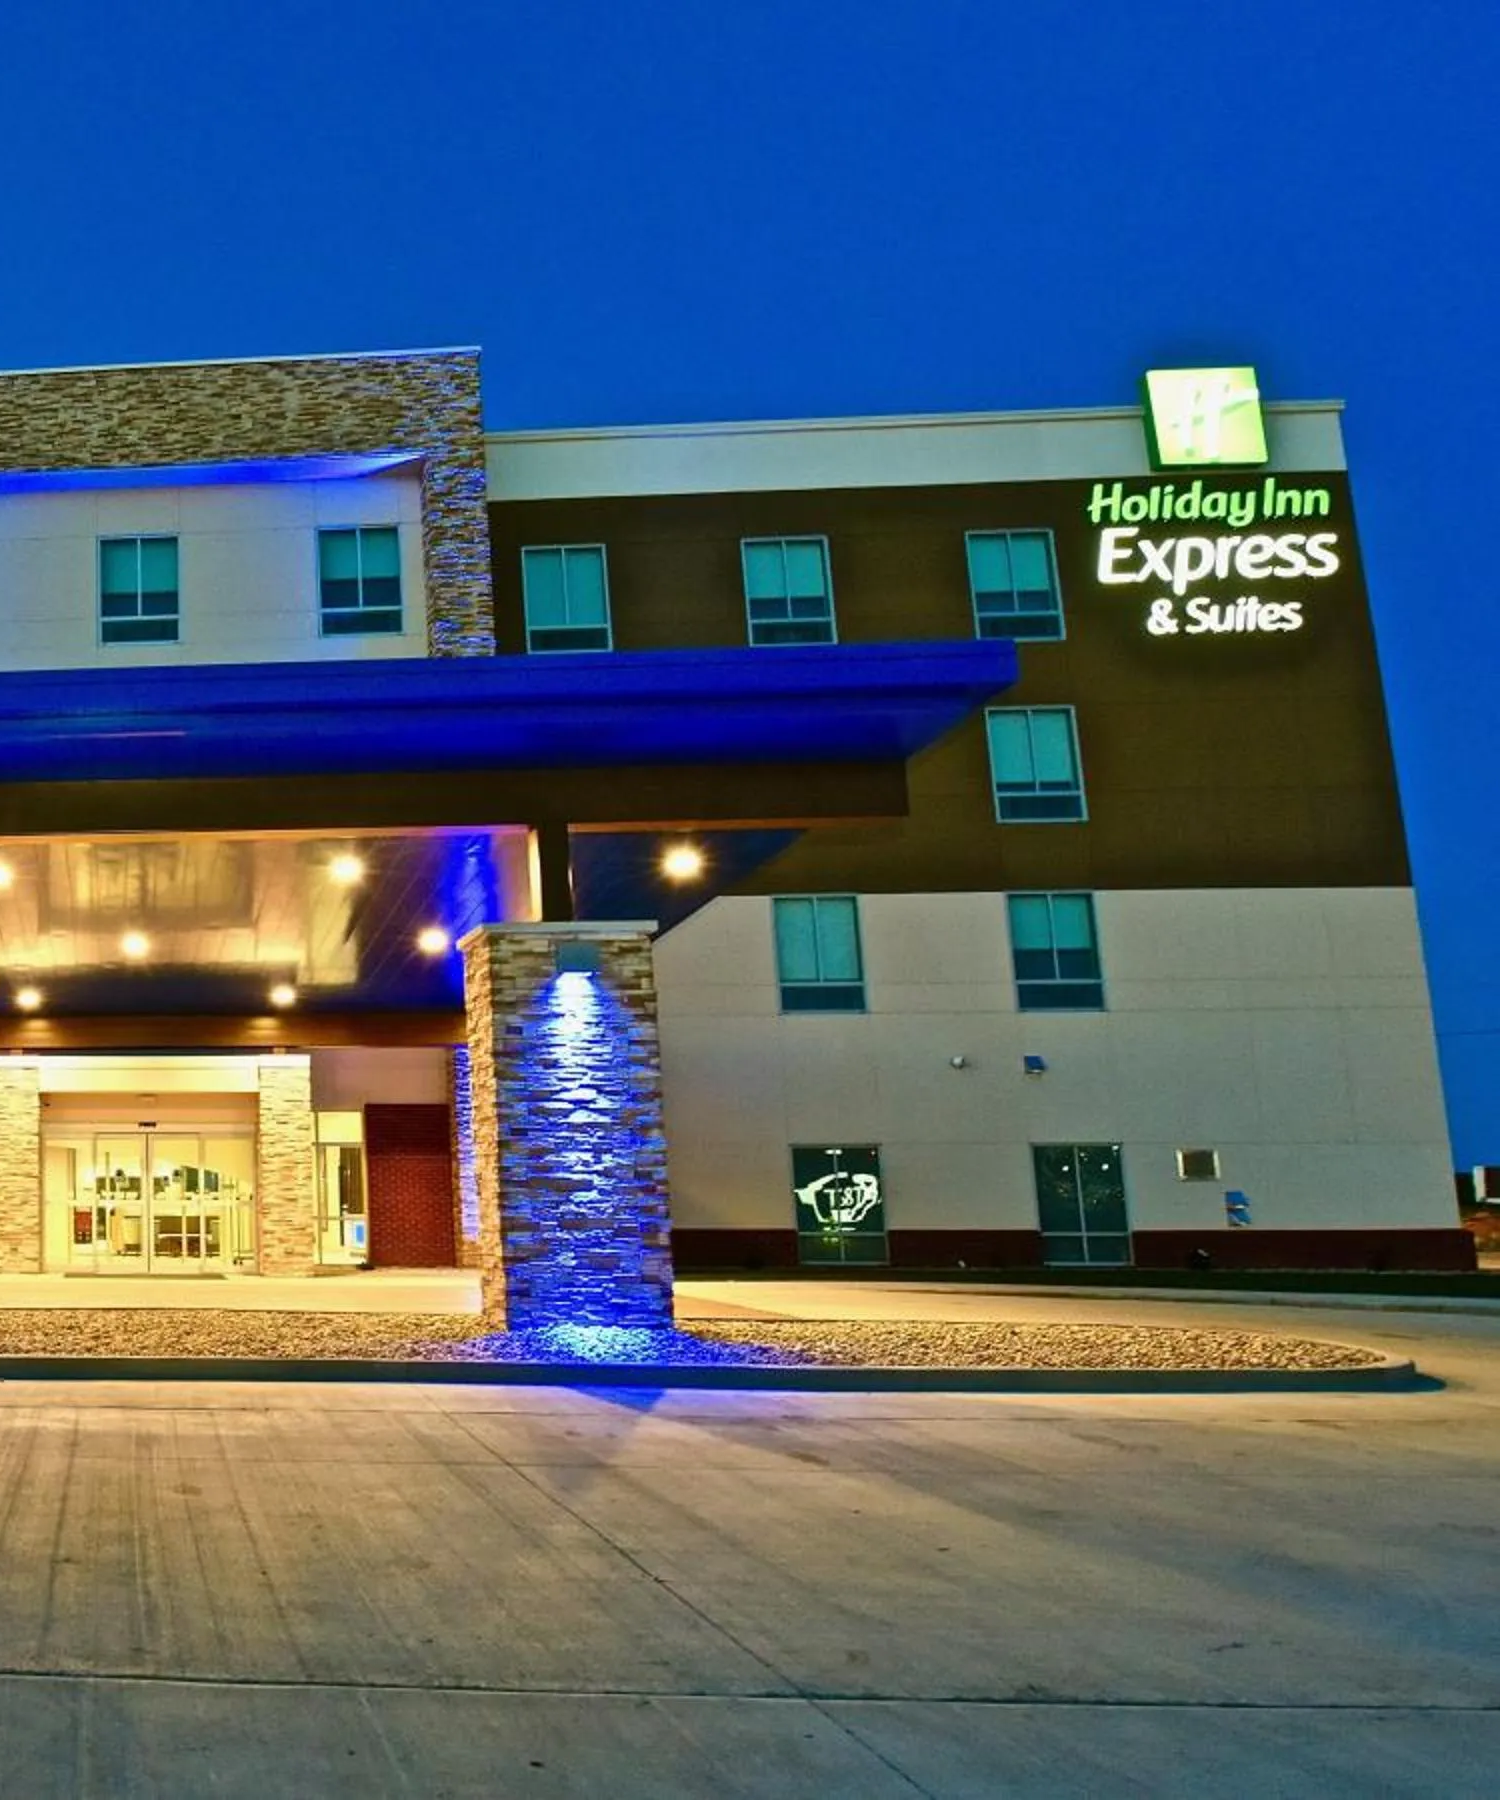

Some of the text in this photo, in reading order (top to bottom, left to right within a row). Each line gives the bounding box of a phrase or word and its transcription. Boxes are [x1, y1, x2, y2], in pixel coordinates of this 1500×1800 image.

[1087, 477, 1330, 527] Holiday Inn
[1097, 526, 1340, 596] Express
[1146, 596, 1303, 635] & Suites
